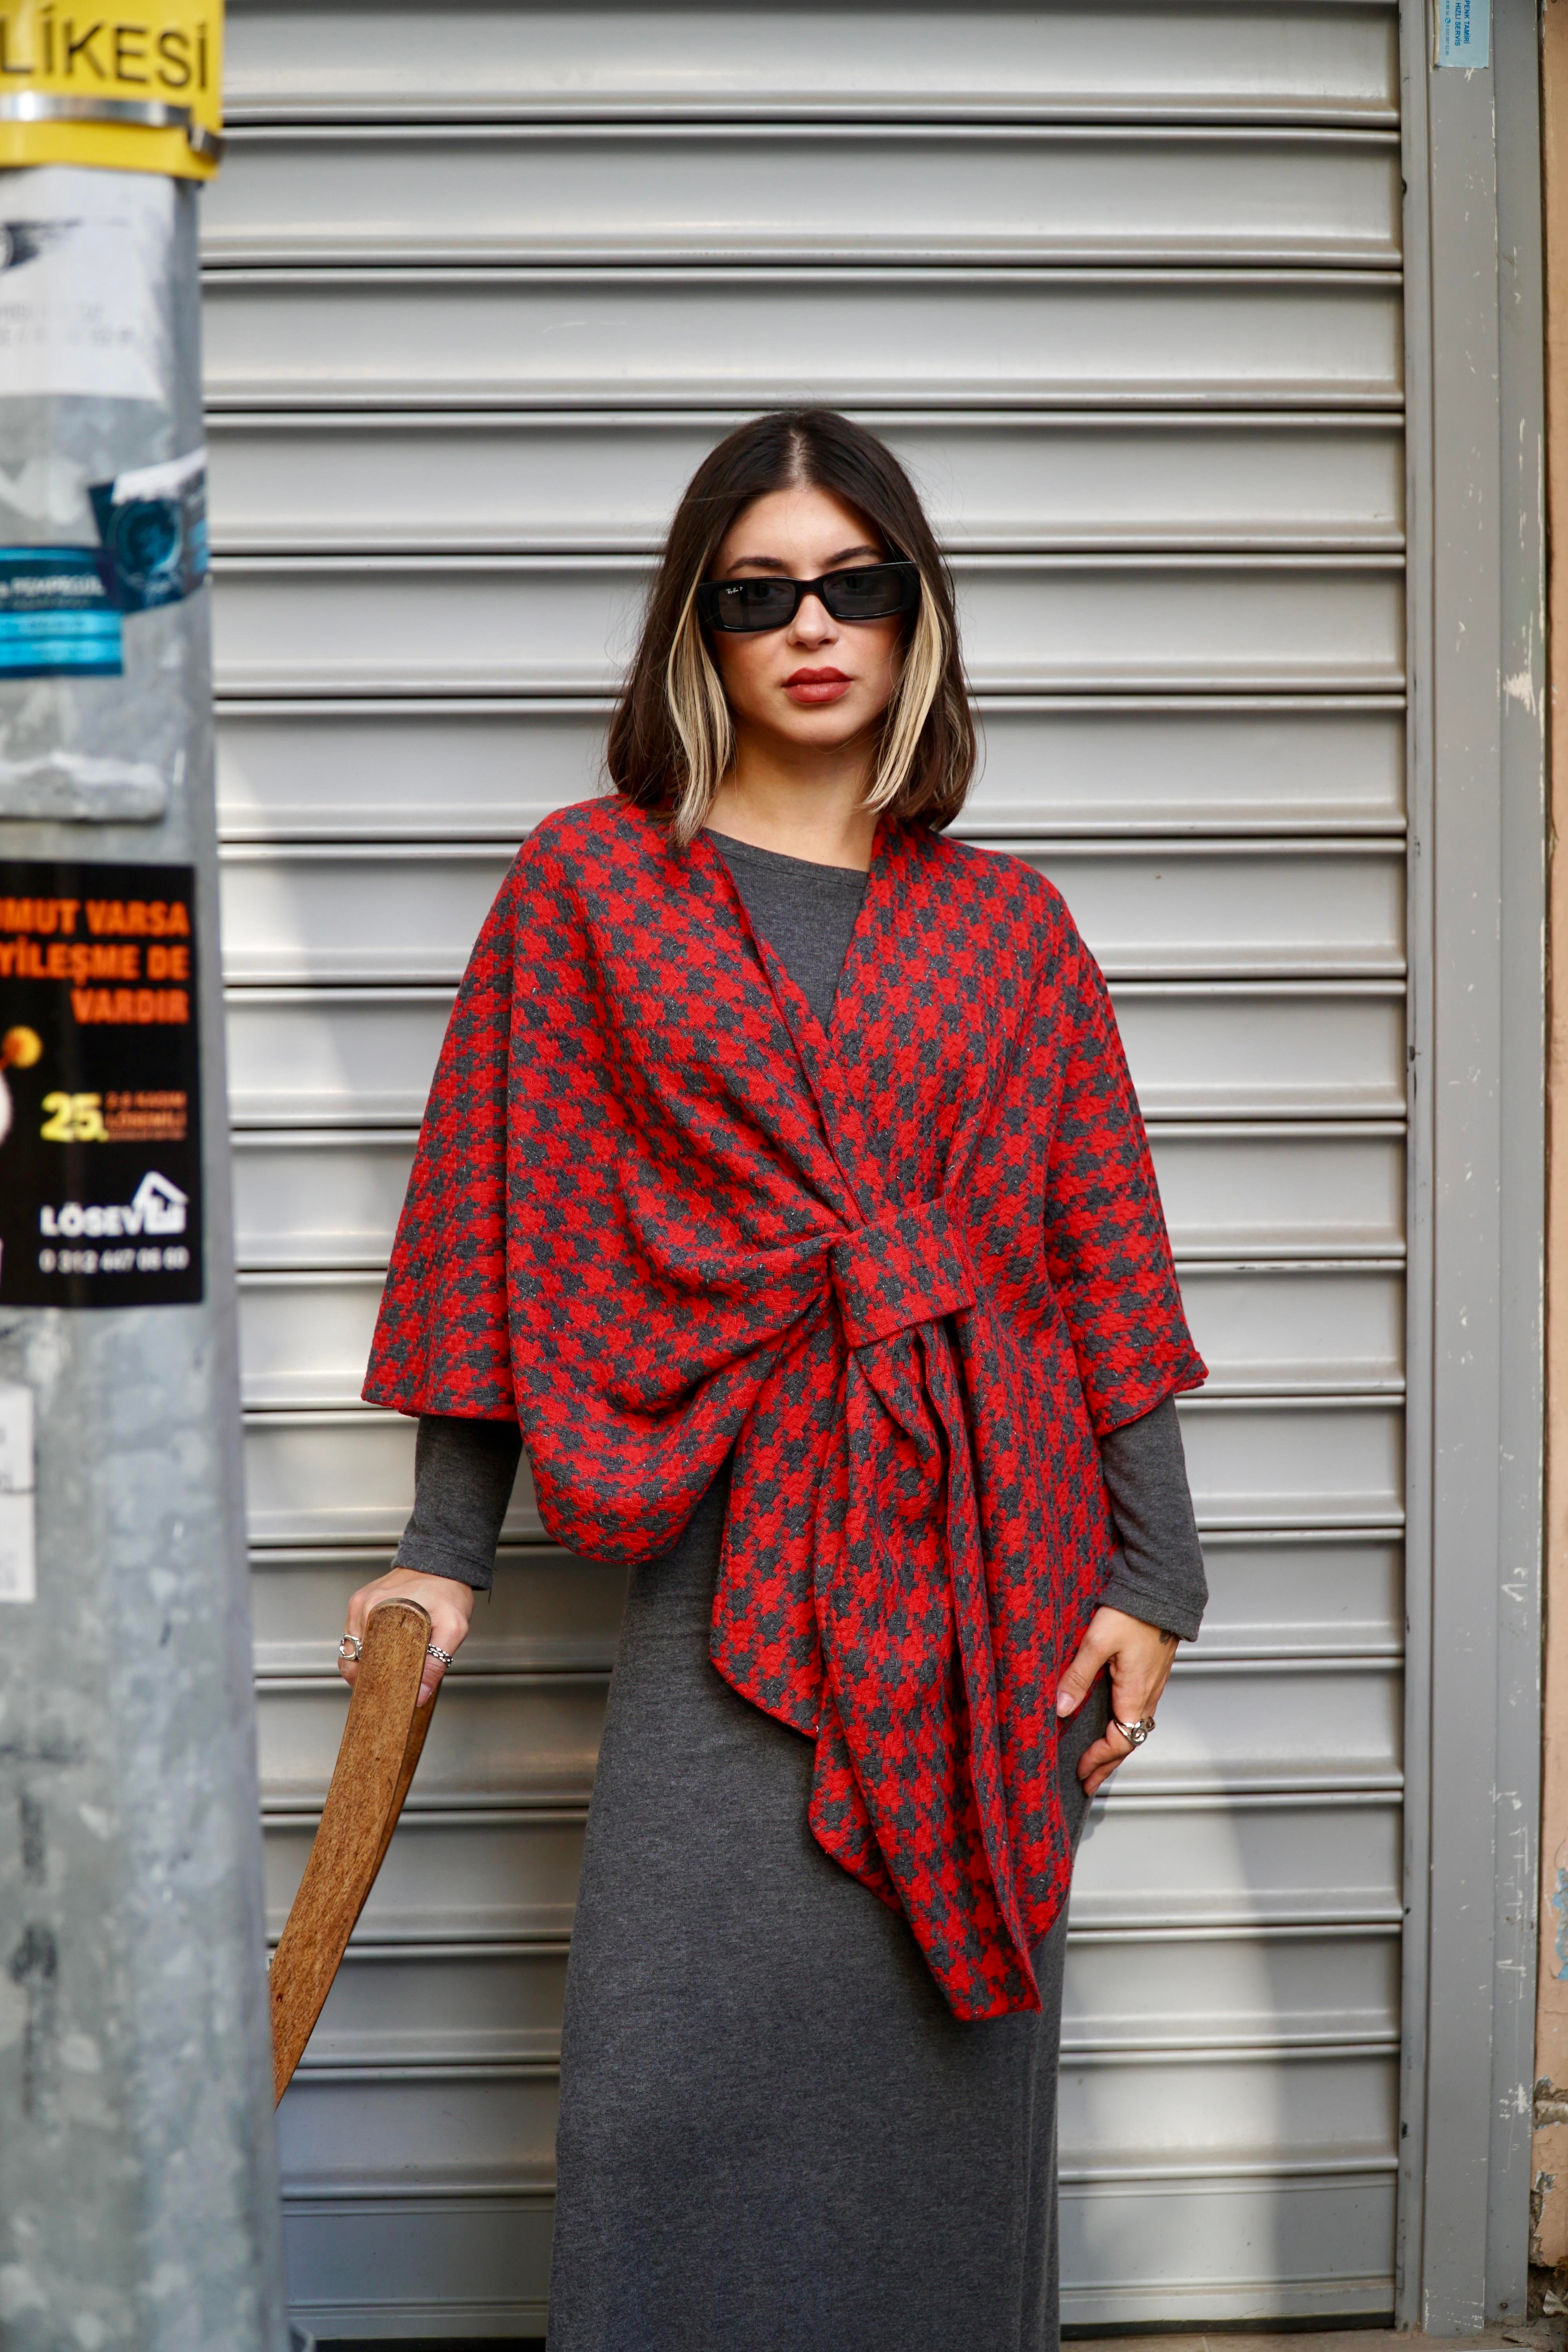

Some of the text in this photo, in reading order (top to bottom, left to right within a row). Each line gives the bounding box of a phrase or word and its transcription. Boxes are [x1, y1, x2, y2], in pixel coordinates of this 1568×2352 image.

[0, 4, 208, 92] LİKESİ
[84, 900, 191, 937] VARSA
[145, 944, 190, 981] DE
[70, 988, 190, 1025] VARDIR
[40, 1201, 143, 1237] LÖSEV
